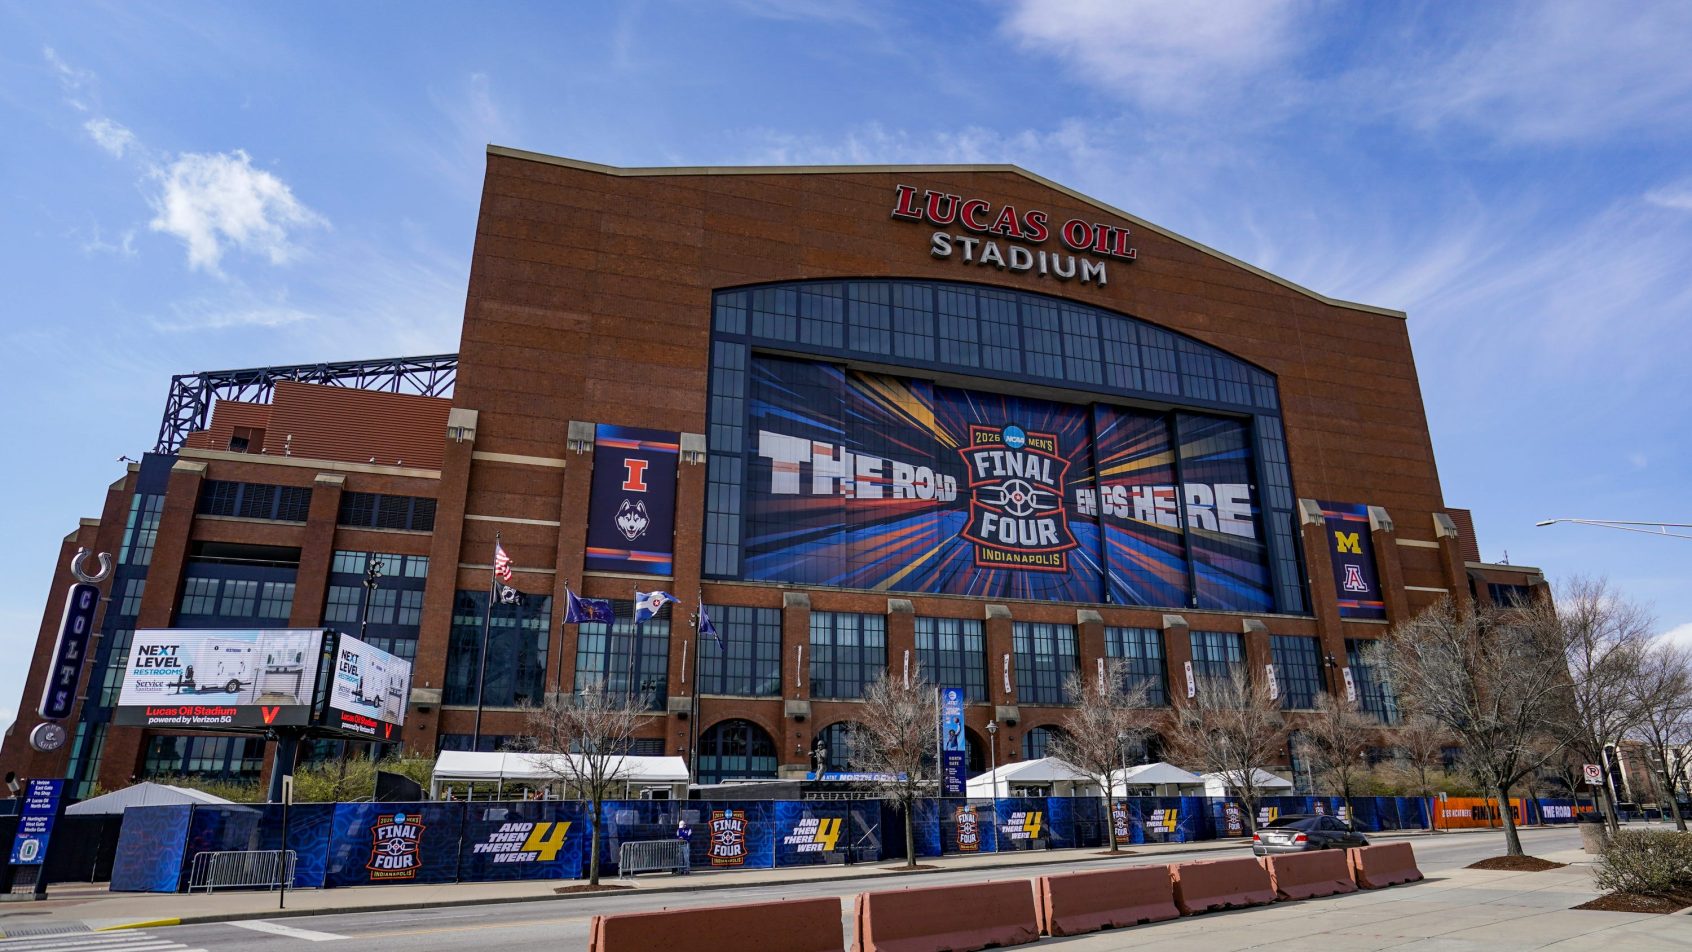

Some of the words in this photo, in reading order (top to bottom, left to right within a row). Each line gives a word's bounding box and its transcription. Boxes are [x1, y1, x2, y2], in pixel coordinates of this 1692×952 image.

[892, 184, 1049, 244] LUCAS
[1061, 218, 1137, 263] OIL
[930, 231, 1107, 287] STADIUM
[976, 432, 1000, 443] 2026
[1005, 435, 1025, 444] NCAA
[1028, 438, 1053, 451] MEN'S
[759, 430, 883, 498] THE
[892, 460, 957, 502] ROAD
[974, 451, 1054, 485] FINAL
[622, 458, 649, 492] I
[1076, 485, 1128, 518] ENDS
[1131, 483, 1256, 539] HERE
[981, 511, 1059, 546] FOUR
[1334, 530, 1361, 554] M
[982, 548, 1060, 565] INDIANAPOLIS
[1343, 564, 1368, 592] A
[53, 590, 92, 711] COLTS
[138, 645, 180, 655] NEXT
[341, 649, 360, 664] NEXT
[136, 657, 181, 667] LEVEL
[339, 661, 359, 676] LEVEL
[136, 679, 164, 687] Service
[146, 706, 177, 716] Lucas
[179, 705, 193, 715] Oil
[194, 706, 237, 715] Stadium
[341, 711, 355, 722] Lucas
[181, 716, 191, 724] by
[958, 814, 975, 823] FINAL
[1542, 806, 1555, 818] THE
[1555, 806, 1571, 818] ROAD
[714, 819, 741, 832] FINAL
[1023, 812, 1042, 839] 4
[1163, 809, 1177, 832] 4
[377, 825, 416, 839] FINAL
[499, 823, 533, 832] AND
[489, 833, 529, 842] THEN
[784, 835, 814, 844] THERE
[814, 818, 842, 851] 4
[960, 834, 976, 843] FOUR
[473, 843, 522, 853] THERE
[521, 822, 572, 861] 4
[797, 844, 823, 852] WERE
[714, 844, 741, 856] FOUR
[374, 855, 413, 868] FOUR
[493, 852, 538, 862] WERE
